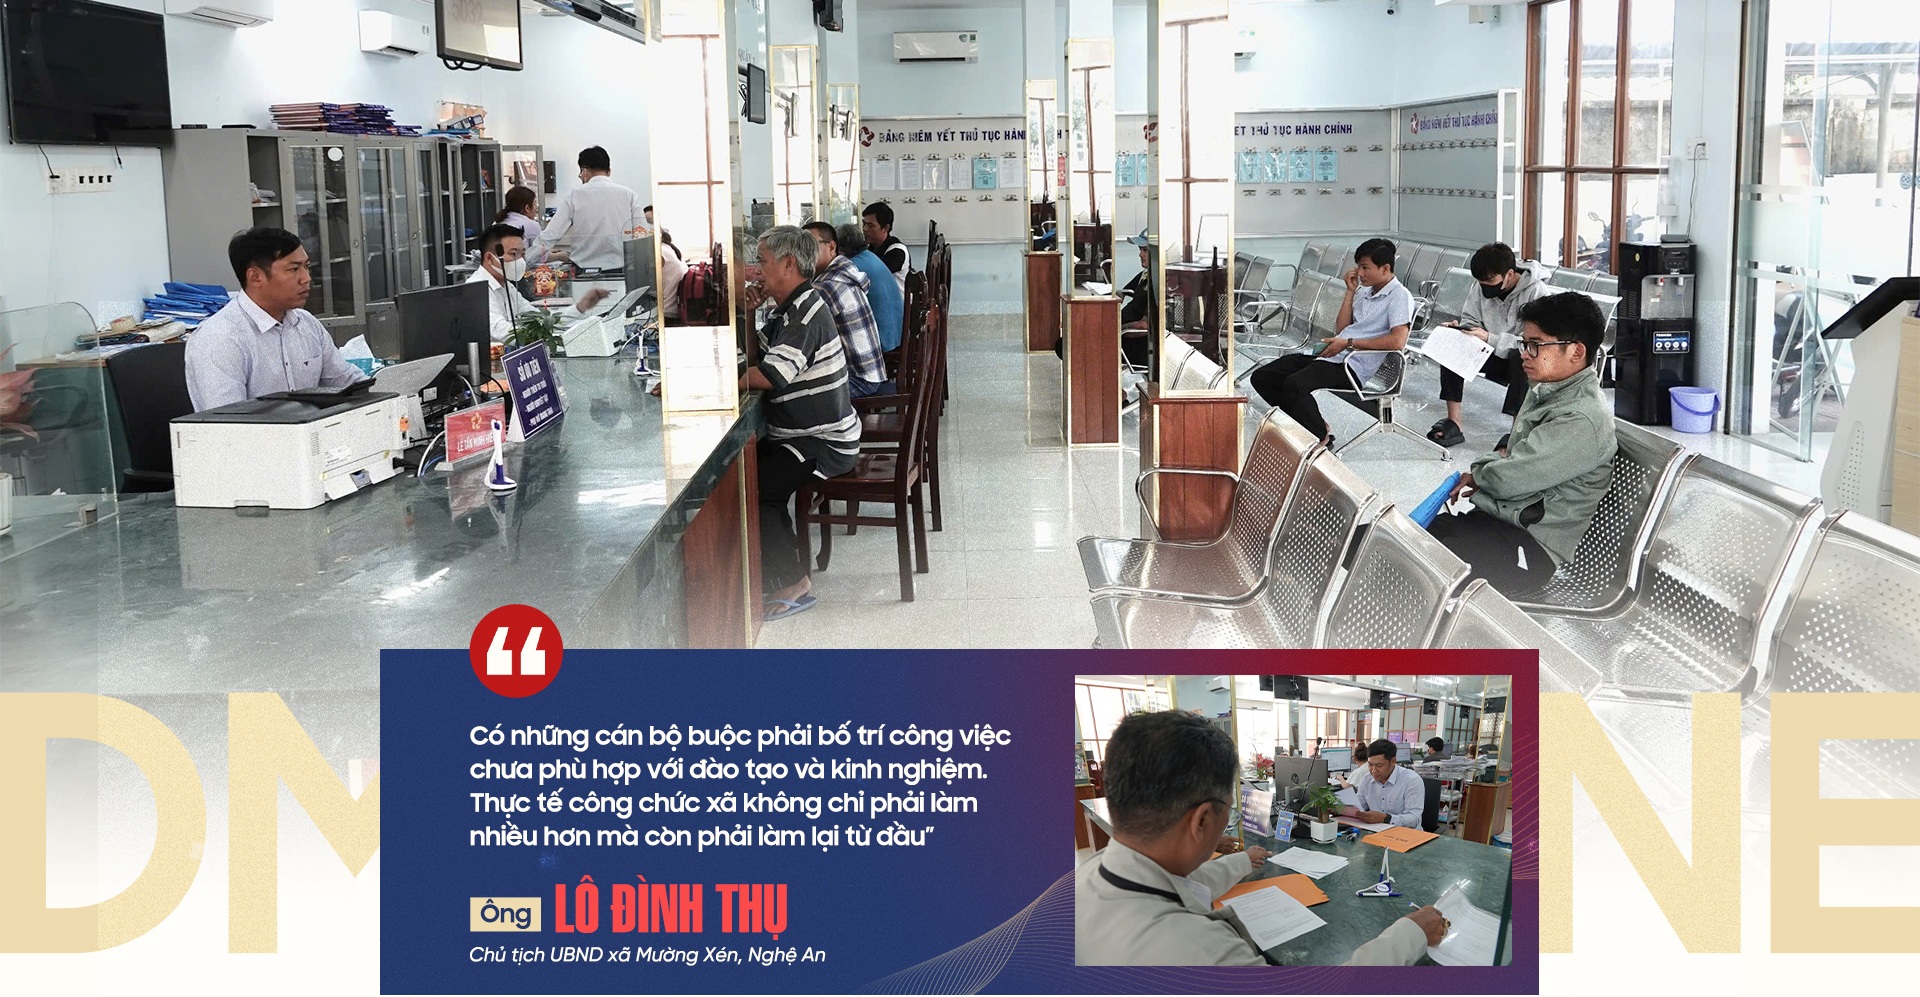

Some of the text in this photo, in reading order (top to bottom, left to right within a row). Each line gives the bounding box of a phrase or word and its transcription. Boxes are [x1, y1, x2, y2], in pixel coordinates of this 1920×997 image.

[879, 128, 905, 143] BẢNG
[936, 127, 955, 142] YẾT
[959, 127, 978, 142] THỦ
[982, 129, 1001, 143] TỤC
[1251, 121, 1269, 136] THỦ
[1273, 124, 1292, 138] TỤC
[1295, 122, 1321, 136] HÀNH
[1324, 121, 1353, 135] CHÍNH
